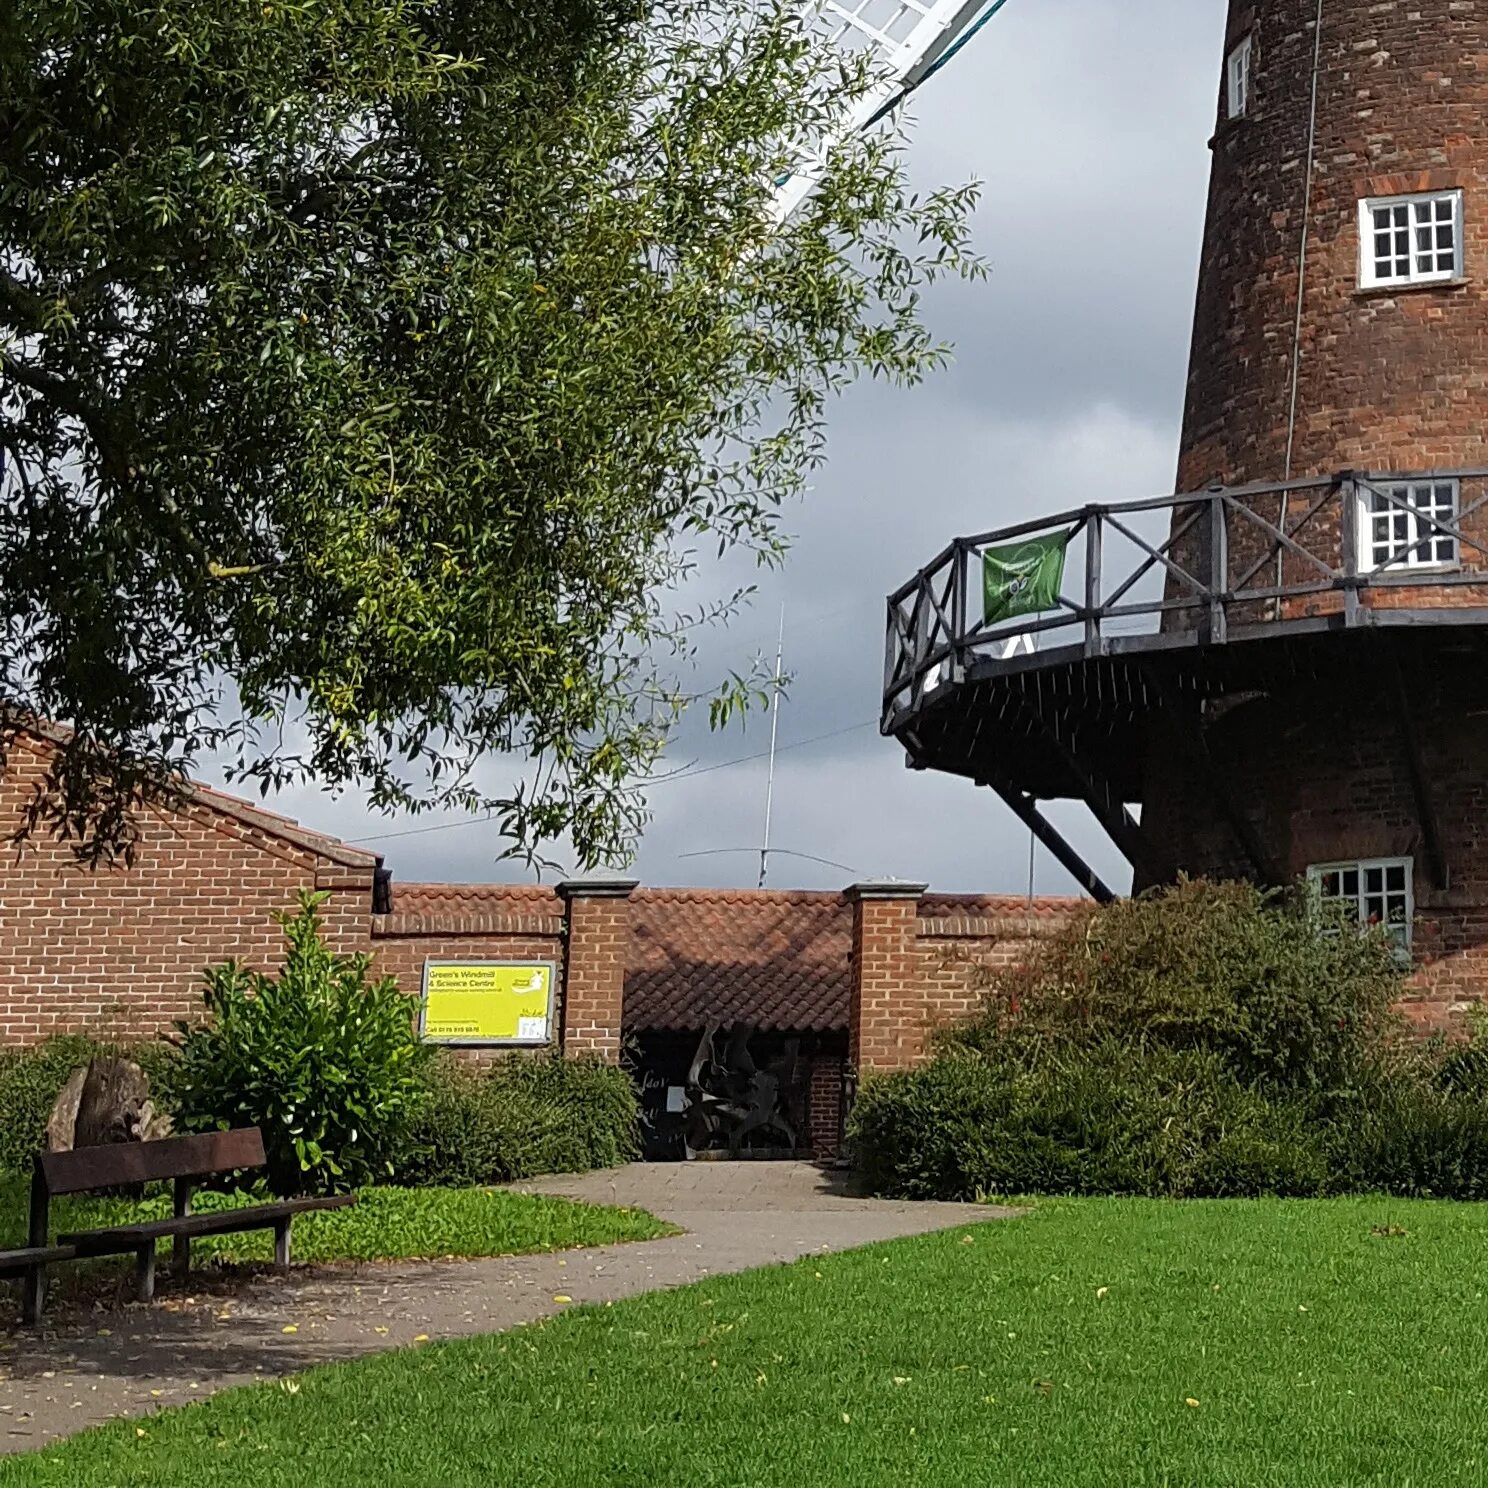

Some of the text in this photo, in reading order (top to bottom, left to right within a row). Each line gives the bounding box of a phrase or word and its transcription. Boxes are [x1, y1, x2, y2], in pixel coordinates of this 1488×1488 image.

[429, 970, 495, 978] Green's Windmill
[436, 979, 467, 987] Science
[469, 979, 495, 987] Centre
